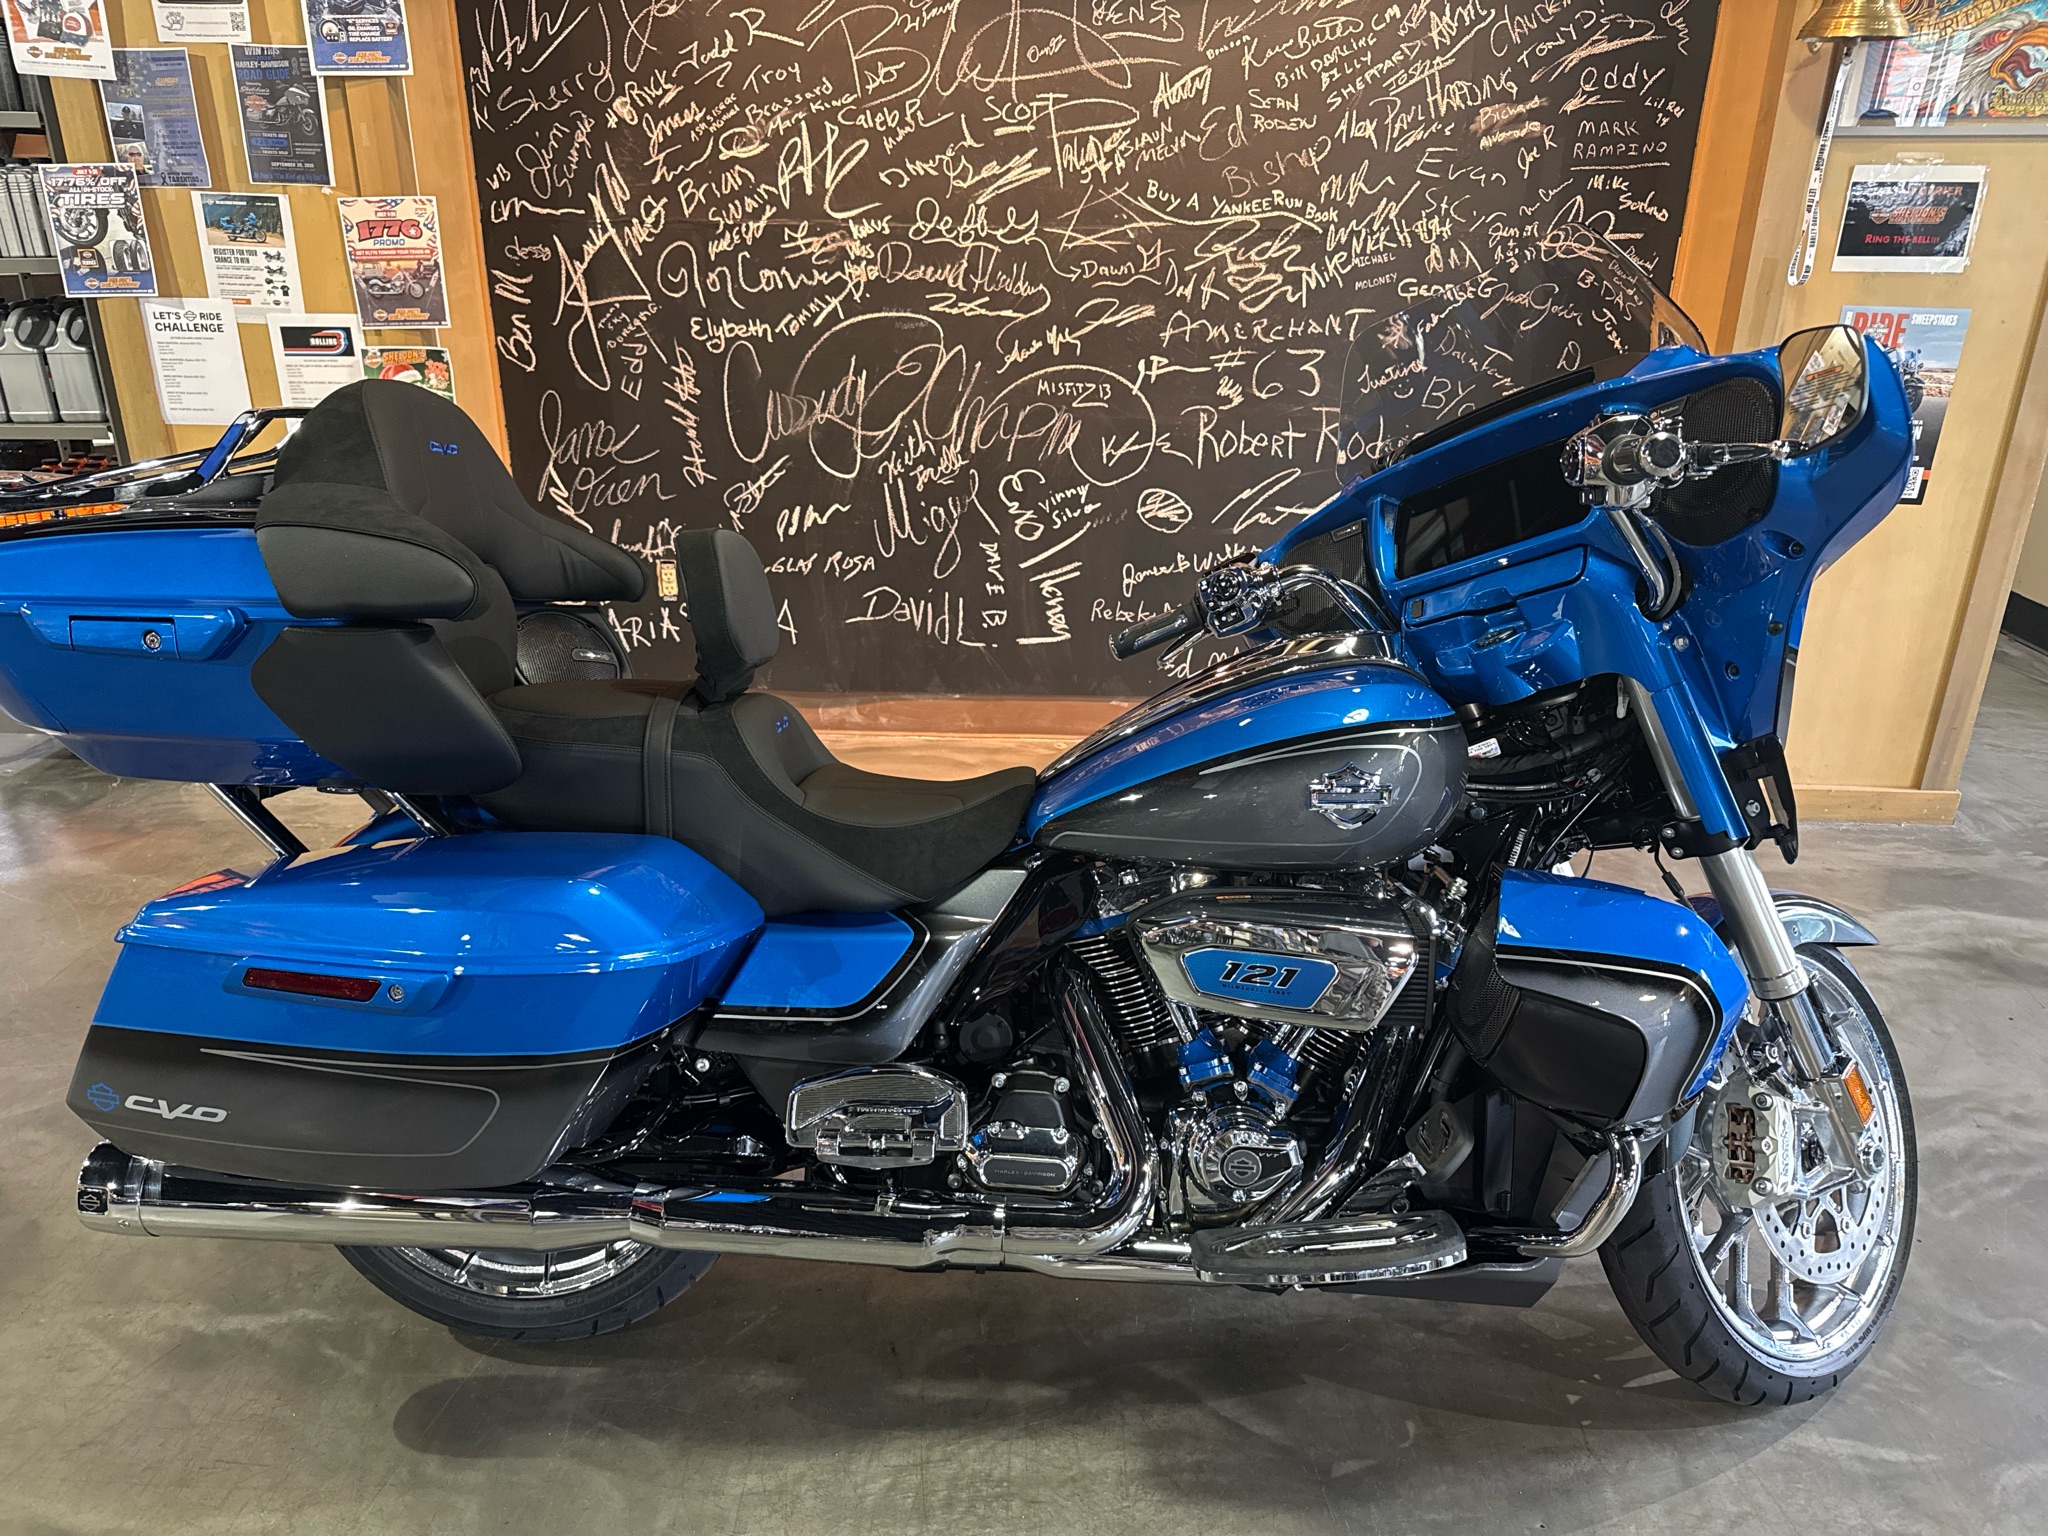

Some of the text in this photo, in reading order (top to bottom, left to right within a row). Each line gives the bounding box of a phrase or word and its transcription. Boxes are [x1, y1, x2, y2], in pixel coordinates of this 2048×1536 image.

[244, 47, 280, 55] WIN THIS
[235, 60, 289, 68] HARLEY-DAVIDSON
[1321, 50, 1372, 91] BILLY
[237, 68, 290, 80] ROAD GLIDE
[743, 62, 801, 94] Troy
[1327, 40, 1422, 112] SHEPPARD
[497, 60, 616, 130] Sherry
[745, 77, 834, 125] Brassard
[838, 105, 899, 132] Caleb
[1334, 110, 1379, 151] Alex
[1577, 120, 1641, 138] MARK
[1573, 141, 1668, 159] RAMPINO
[1416, 147, 1507, 188] Evan
[50, 177, 127, 187] 17.76% OFF
[60, 193, 125, 204] TIRES
[678, 165, 755, 218] Brian
[1186, 192, 1200, 212] A
[1210, 195, 1272, 219] YANKEE
[356, 219, 423, 242] 1776
[1865, 234, 1890, 243] RING
[1912, 236, 1940, 244] BELL!!!
[213, 248, 235, 256] REGISTER
[1352, 252, 1397, 268] MICHAEL
[1354, 273, 1398, 291] MOLONEY
[153, 311, 222, 320] LET'S RIDE
[1911, 314, 1959, 326] SWEEPSTAKES
[155, 323, 225, 333] CHALLENGE
[1180, 405, 1306, 469] Robert
[430, 441, 459, 455] CVO
[1219, 960, 1302, 989] 121
[124, 1095, 228, 1123] CVO
